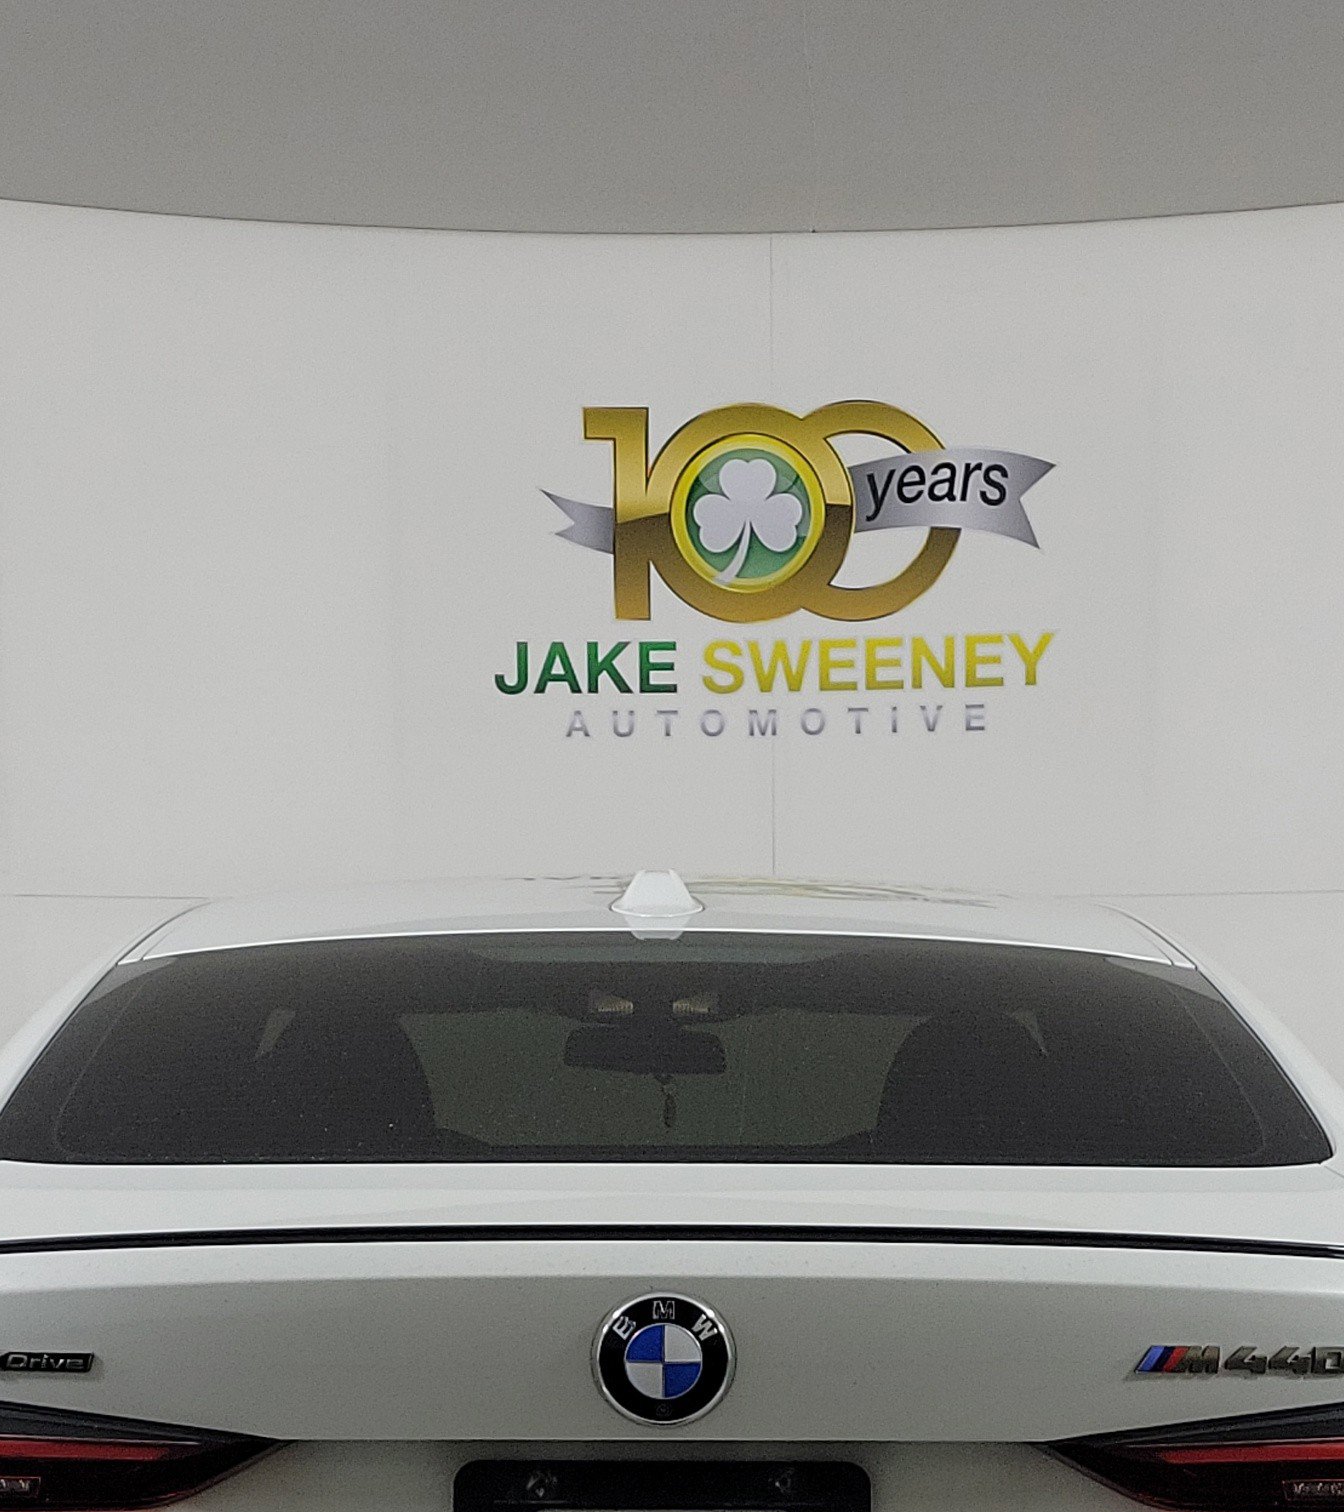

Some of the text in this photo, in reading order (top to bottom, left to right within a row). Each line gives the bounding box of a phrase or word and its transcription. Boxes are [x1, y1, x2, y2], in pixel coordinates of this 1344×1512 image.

[582, 399, 963, 623] 100
[864, 461, 1010, 521] years
[494, 632, 1054, 695] JAKE SWEENEY
[566, 704, 987, 738] AUTOMOTIVE
[612, 1300, 717, 1341] BMW
